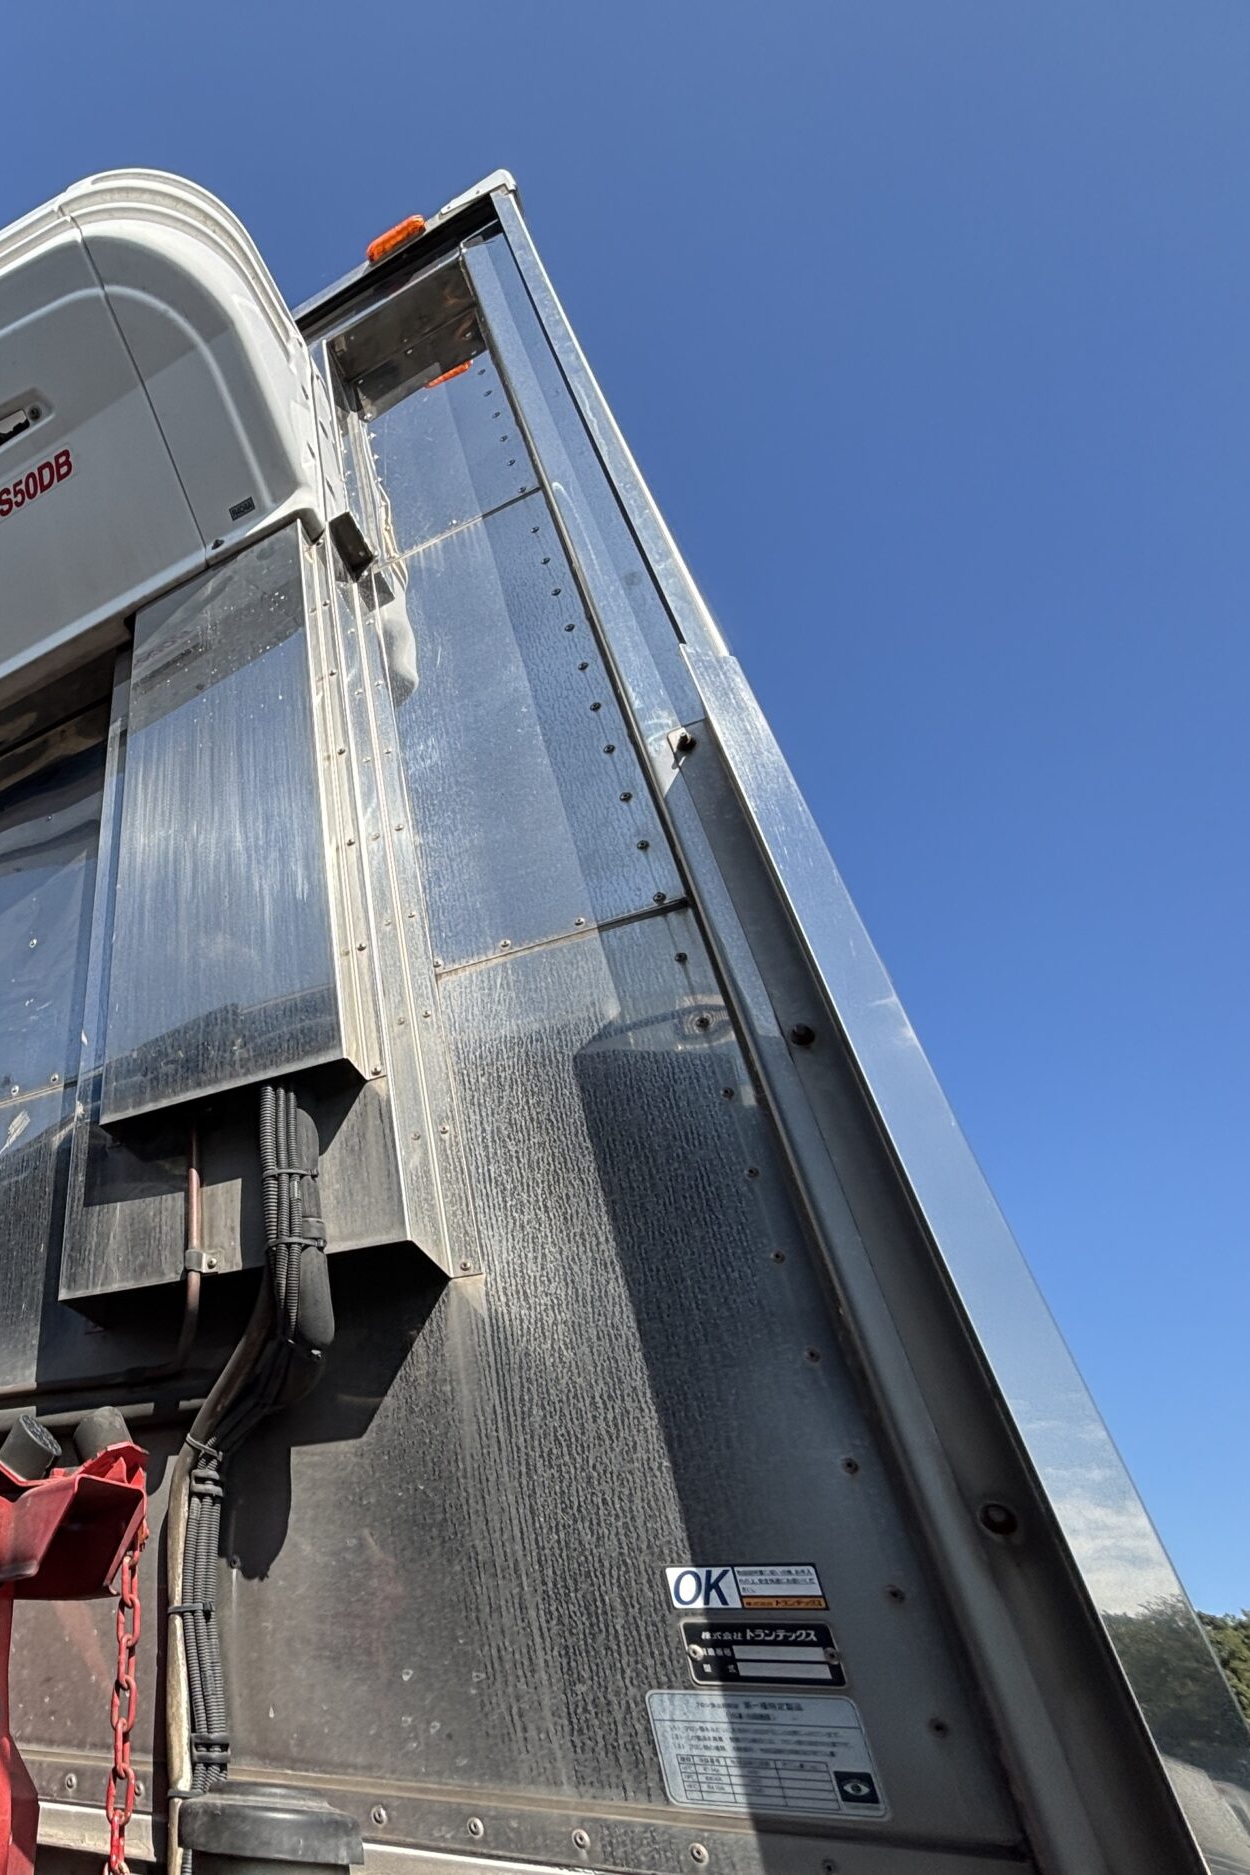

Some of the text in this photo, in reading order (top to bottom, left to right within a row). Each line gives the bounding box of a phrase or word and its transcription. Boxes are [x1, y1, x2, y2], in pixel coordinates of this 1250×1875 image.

[673, 1569, 731, 1606] OK
[746, 1628, 818, 1642] トランテックス
